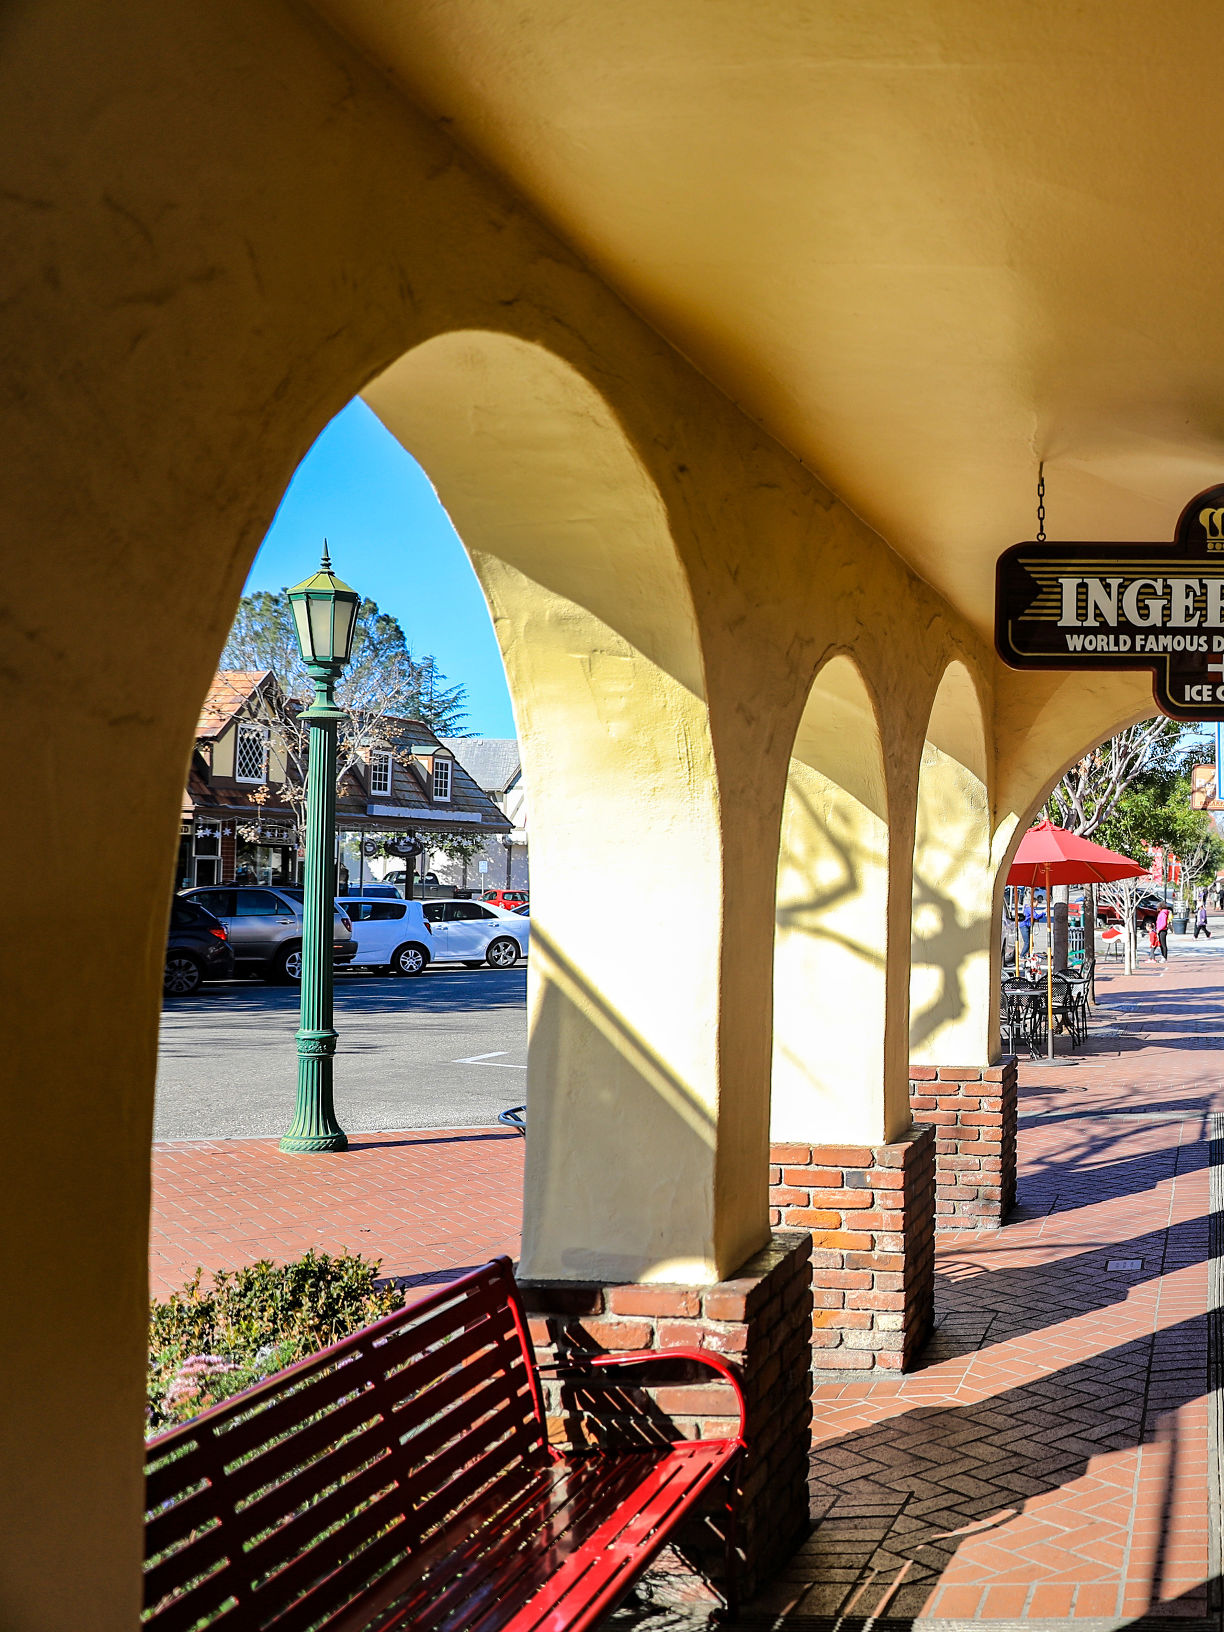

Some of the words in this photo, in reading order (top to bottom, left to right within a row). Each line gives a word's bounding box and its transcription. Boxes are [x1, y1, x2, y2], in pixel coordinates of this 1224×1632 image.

[1066, 634, 1131, 652] WORLD
[1135, 635, 1208, 652] FAMOUS
[1185, 685, 1212, 702] ICE
